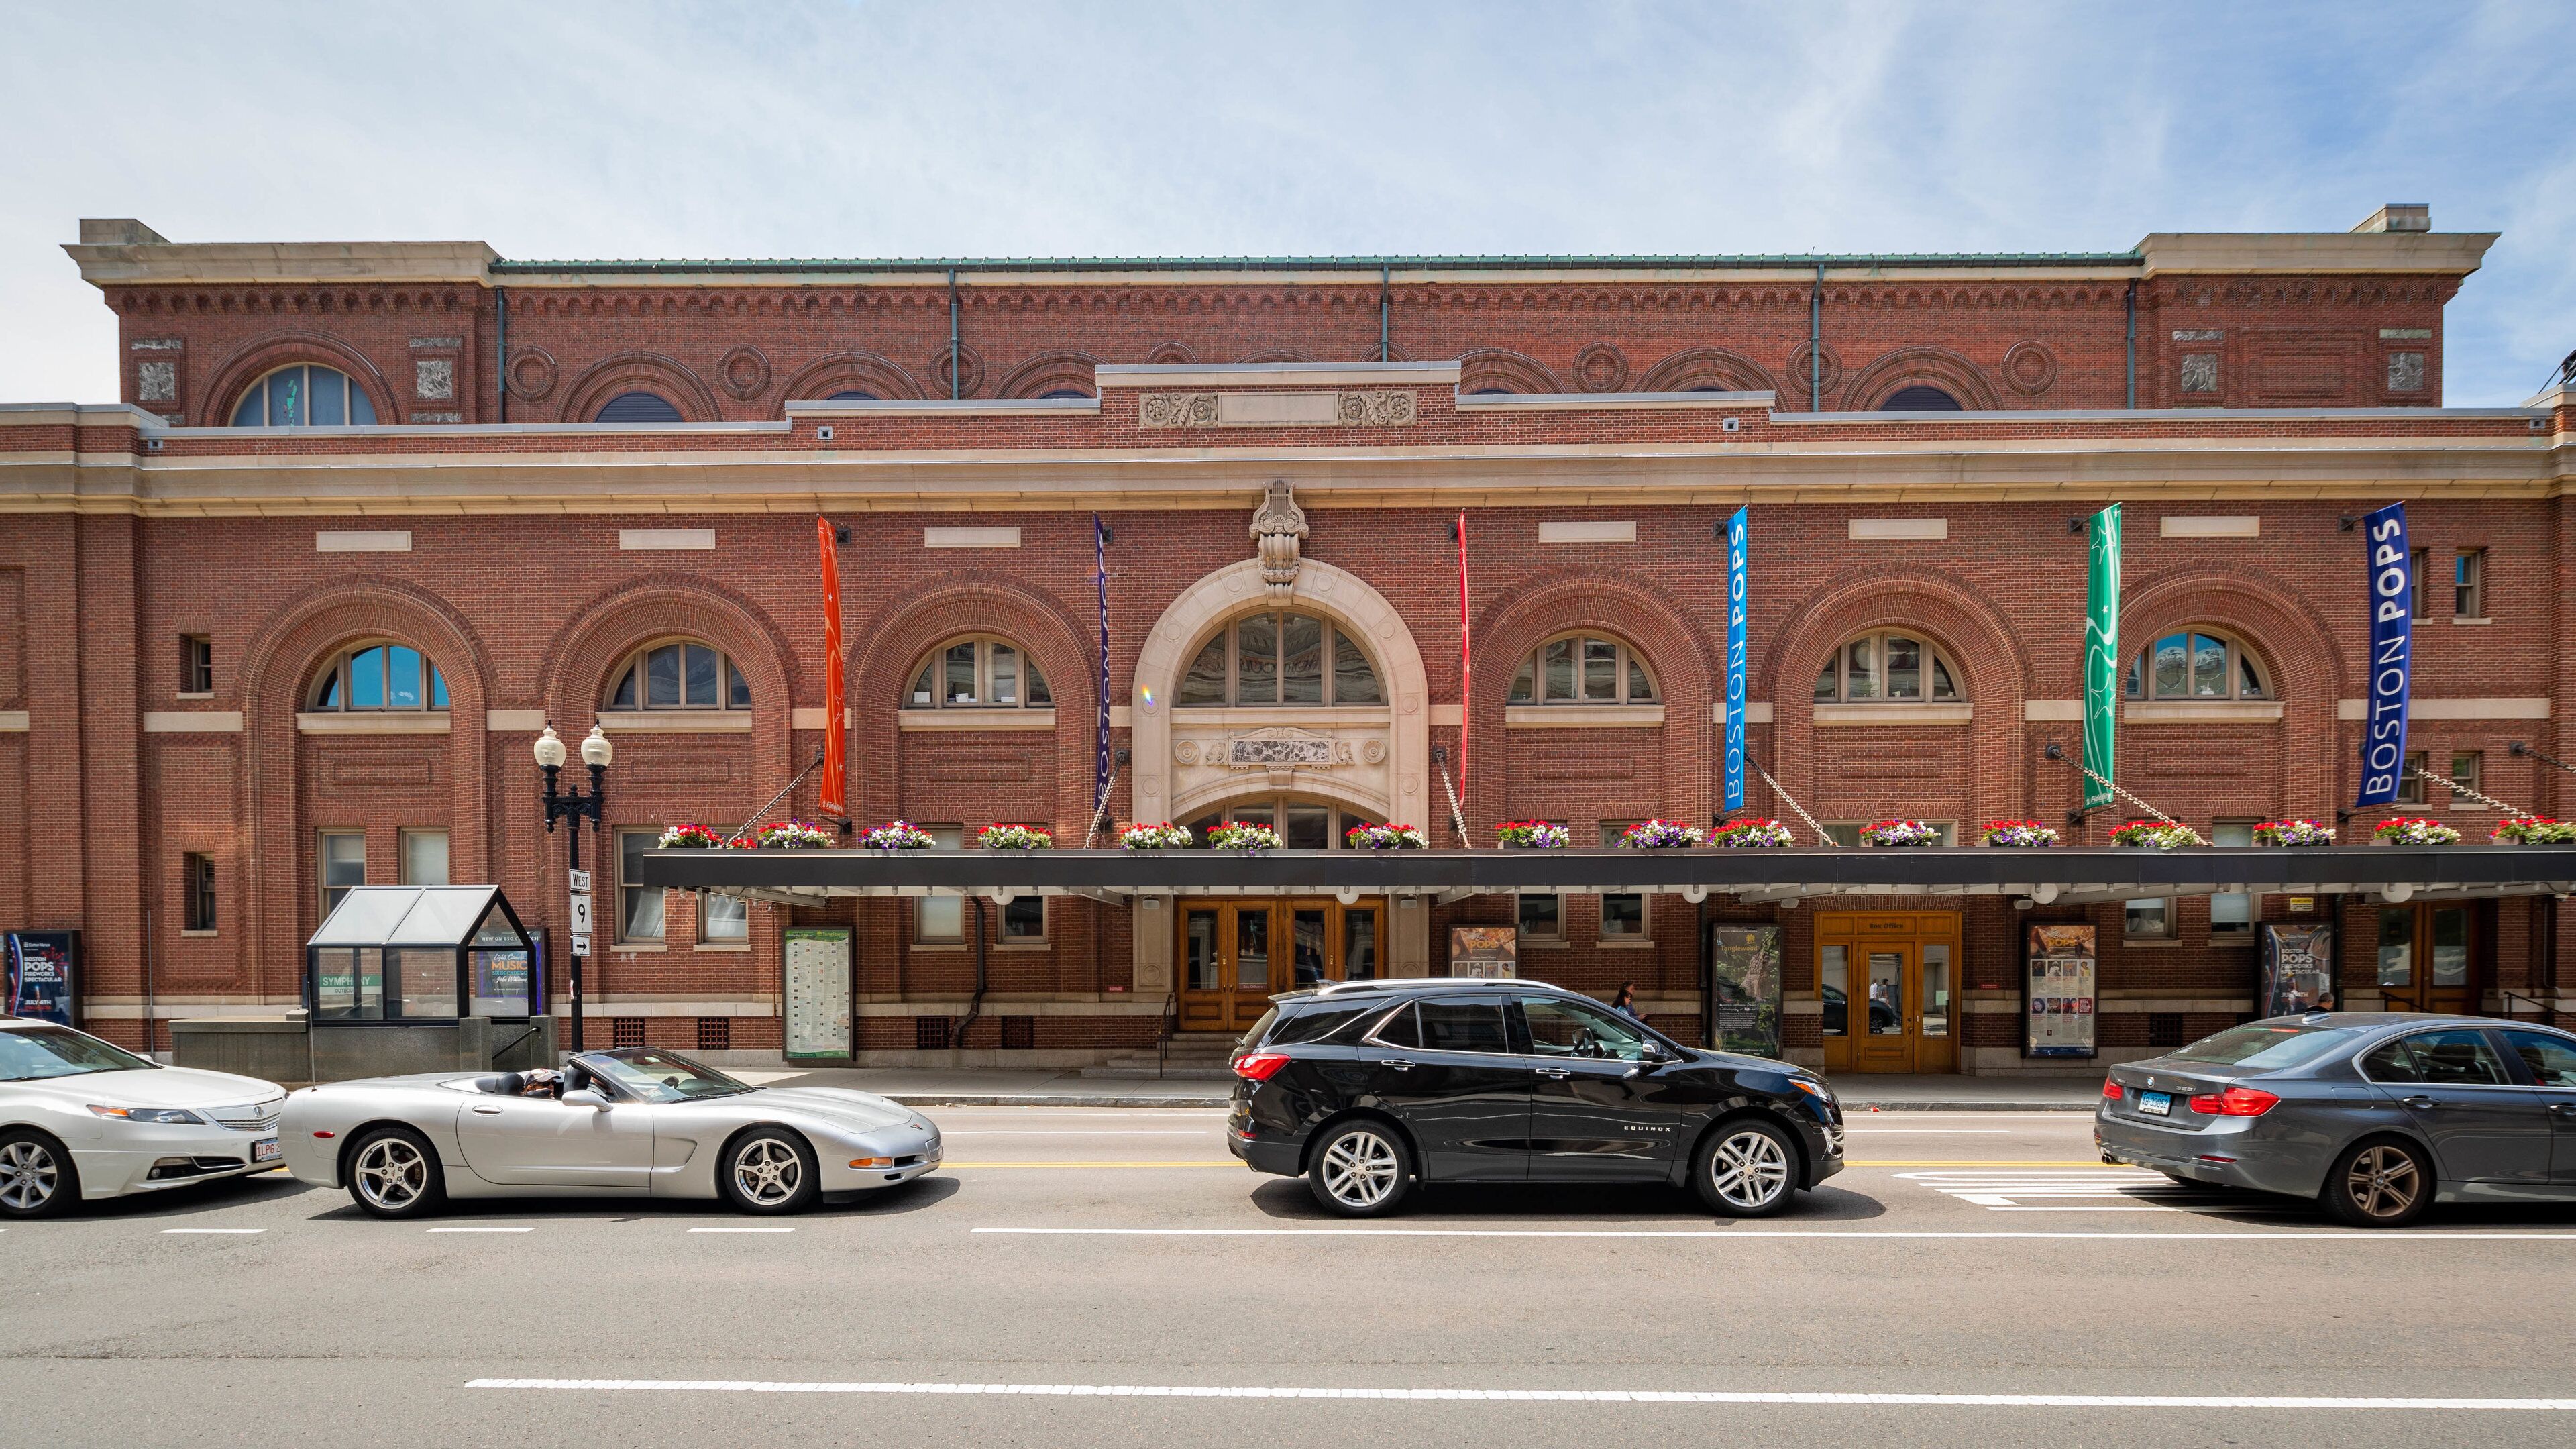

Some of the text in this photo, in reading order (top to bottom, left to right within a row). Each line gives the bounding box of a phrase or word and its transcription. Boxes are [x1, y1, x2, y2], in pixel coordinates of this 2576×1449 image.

[1727, 523, 1745, 799] BOSTON POPS
[2366, 518, 2406, 795] BOSTON POPS
[1098, 645, 1110, 800] BOSTON
[572, 873, 588, 888] WEST
[578, 903, 586, 924] 9
[1467, 940, 1499, 949] POPS
[2281, 953, 2314, 963] POPS
[24, 961, 55, 971] POPS
[491, 961, 528, 971] MUSIC
[322, 977, 370, 986] SYMPHNY
